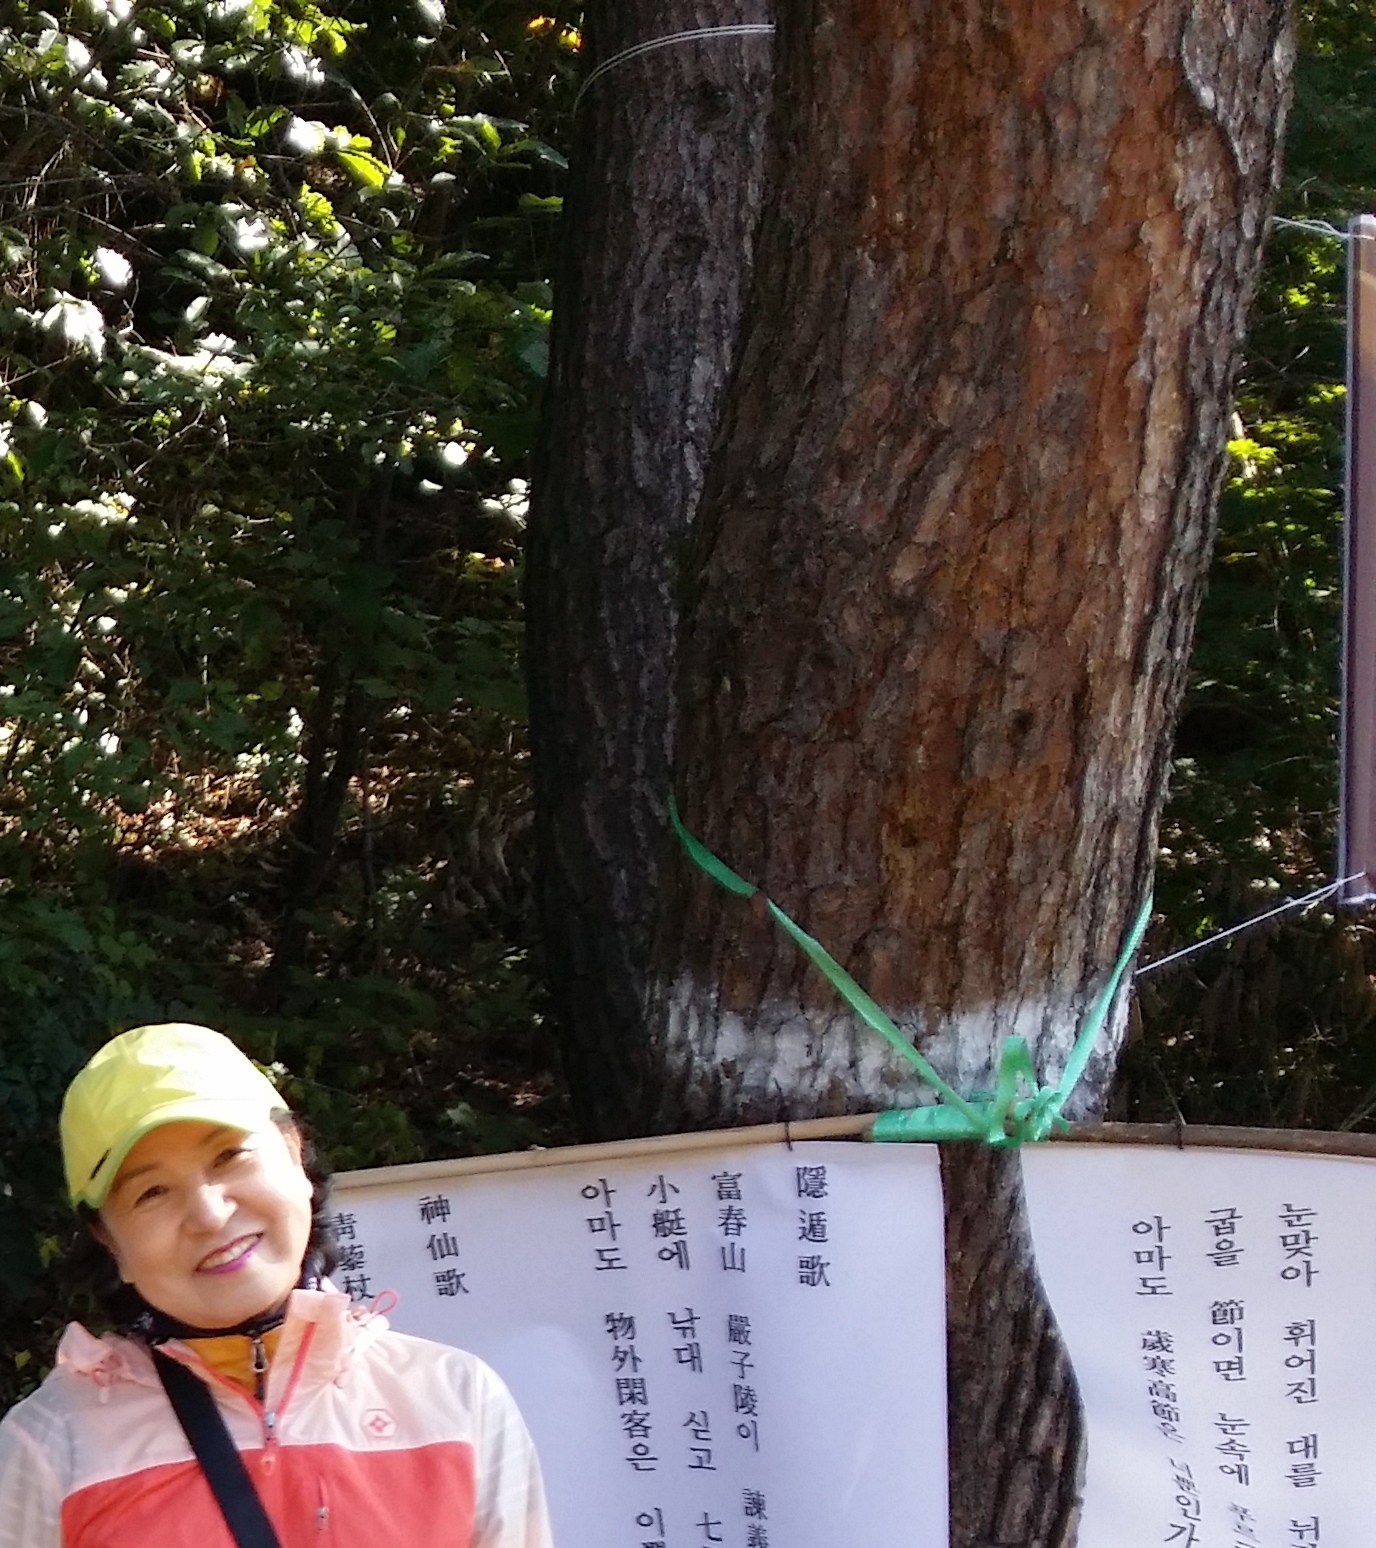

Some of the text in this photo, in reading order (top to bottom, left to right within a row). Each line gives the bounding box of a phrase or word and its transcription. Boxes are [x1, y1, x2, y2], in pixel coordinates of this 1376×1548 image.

[417, 1194, 470, 1297] 神仙歌
[580, 1178, 628, 1272] 아마도
[647, 1174, 690, 1271] 小艇에
[711, 1171, 747, 1273] 富春山
[1132, 1215, 1173, 1297] 아마도
[1205, 1207, 1245, 1267] 굽을
[1278, 1203, 1319, 1287] 눈맞아
[1209, 1300, 1247, 1382] 節이면
[1283, 1319, 1319, 1404] 휘어진
[1214, 1412, 1251, 1486] 눈속에
[1285, 1433, 1322, 1488] 대를
